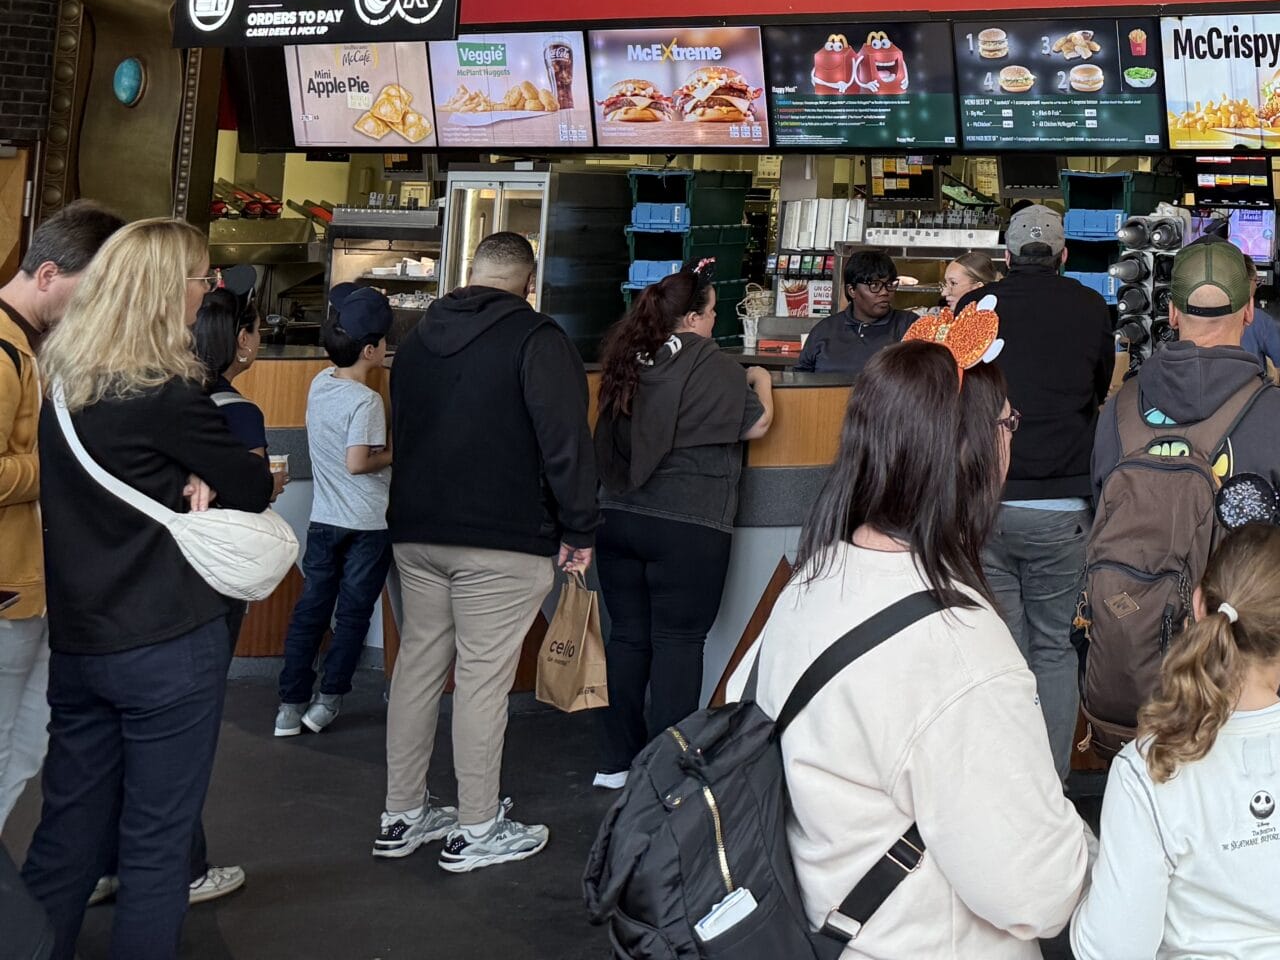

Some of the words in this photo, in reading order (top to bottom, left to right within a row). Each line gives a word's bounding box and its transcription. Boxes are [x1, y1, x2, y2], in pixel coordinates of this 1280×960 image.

[248, 12, 297, 25] ORDERS
[299, 11, 316, 24] TO
[317, 10, 344, 23] PAY
[315, 26, 328, 35] UP
[966, 33, 974, 54] 1
[1041, 36, 1050, 55] 3
[342, 50, 372, 66] McCafé
[460, 46, 503, 65] Veggie
[314, 70, 332, 79] Mini
[983, 71, 993, 90] 4
[1057, 71, 1067, 89] 2
[307, 76, 347, 98] Apple
[347, 76, 370, 93] Pie
[549, 640, 575, 657] celio
